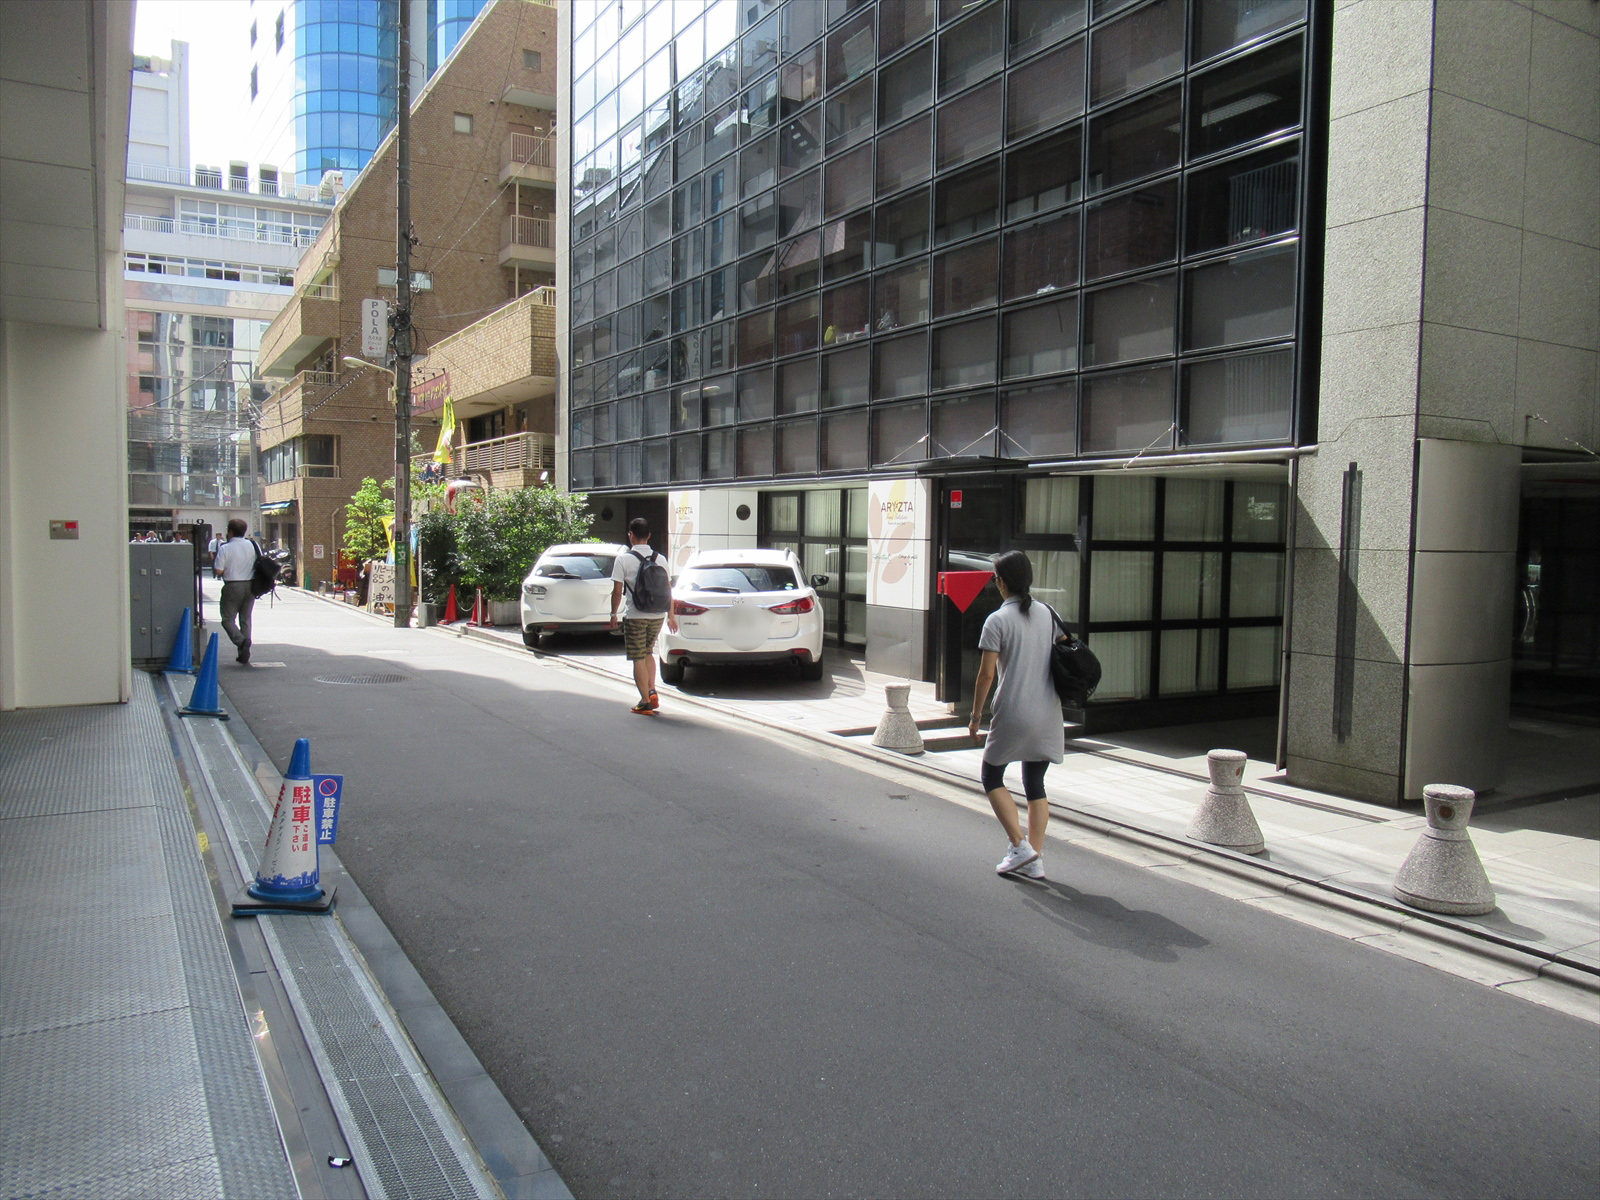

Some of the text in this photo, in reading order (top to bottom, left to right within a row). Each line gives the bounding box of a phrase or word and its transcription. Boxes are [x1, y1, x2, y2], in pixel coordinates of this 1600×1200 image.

[371, 301, 379, 335] POLA
[880, 501, 914, 513] ARYZTA
[291, 785, 311, 824] 駐車
[319, 797, 337, 840] 駐車禁止
[291, 825, 301, 853] 下さい
